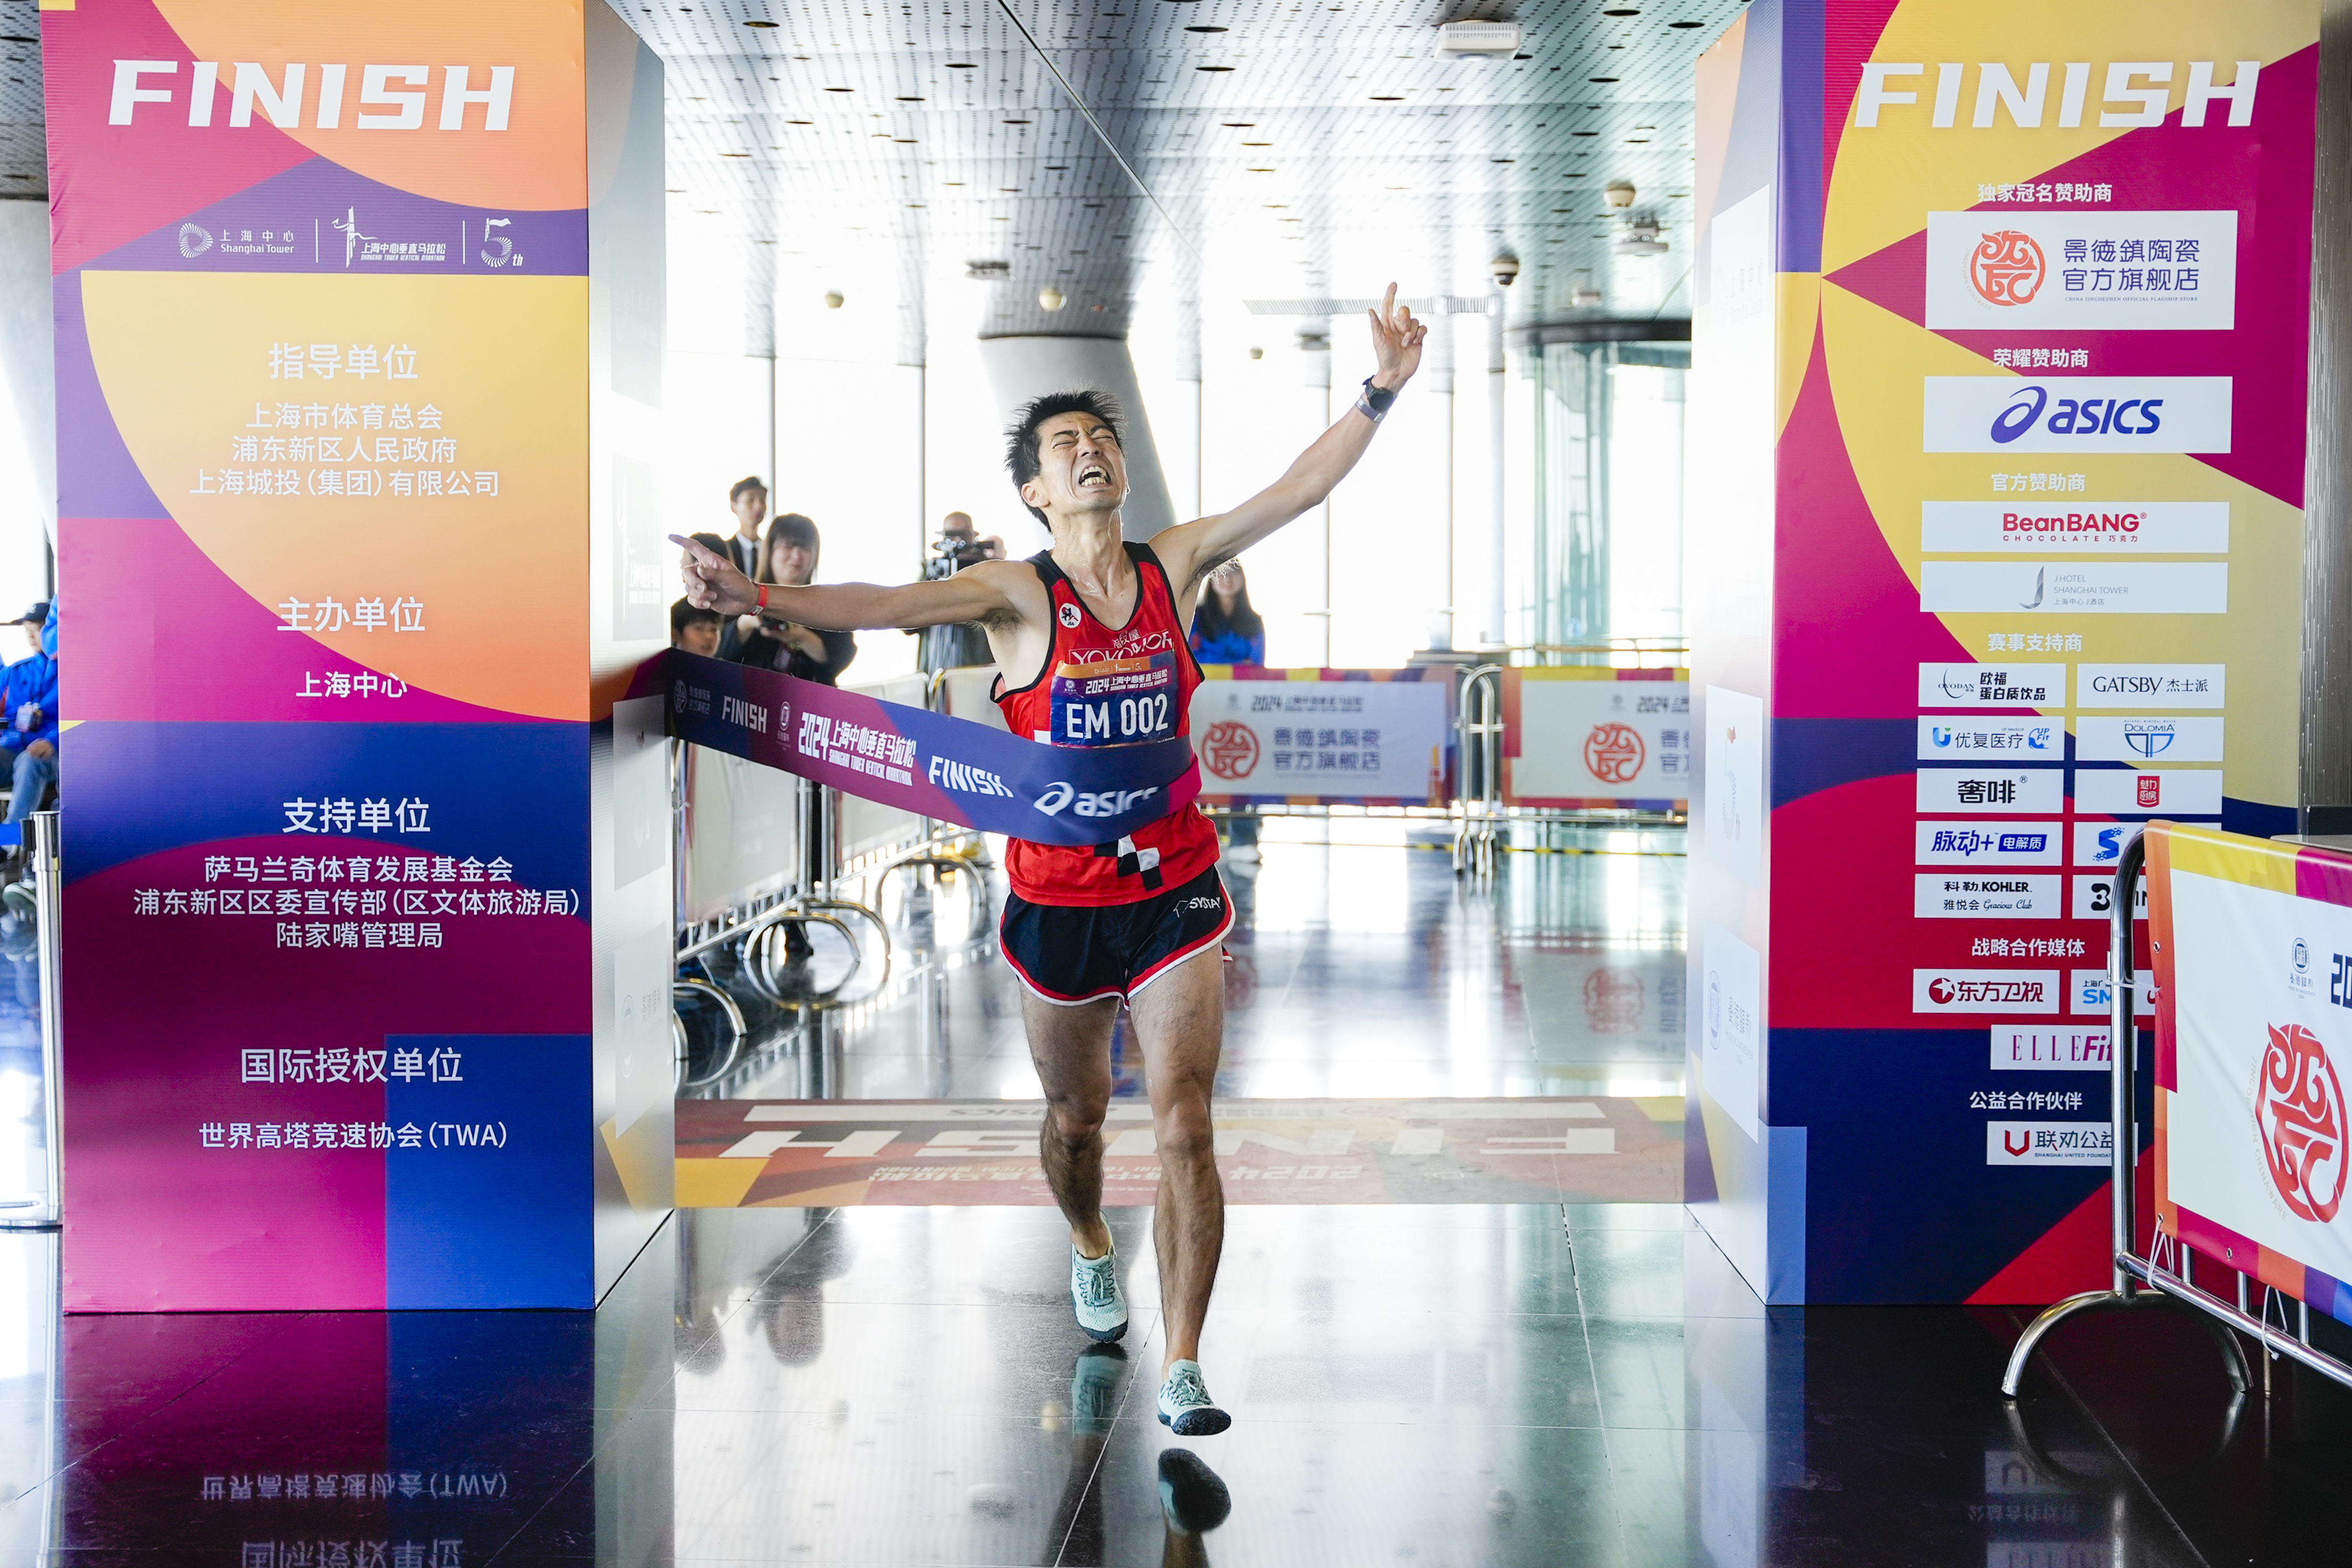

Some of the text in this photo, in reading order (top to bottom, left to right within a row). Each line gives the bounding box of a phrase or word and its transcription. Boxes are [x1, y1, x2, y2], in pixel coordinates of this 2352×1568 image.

[108, 59, 515, 131] FINISH
[1854, 61, 2261, 129] FINISH
[1977, 183, 2112, 202] 独家冠名赞助商
[220, 229, 294, 242] 上海中心
[221, 244, 294, 255] Shanghai Tower
[361, 243, 445, 254] 上海中心垂直马拉松
[2062, 268, 2199, 291] 官方旗舰店
[269, 343, 418, 379] 指导单位
[1993, 349, 2089, 367] 荣耀赞助商
[246, 402, 443, 430] 上海市体育总会
[232, 435, 457, 463] 浦东新区人民政府
[1991, 473, 2086, 491] 官方赞助商
[277, 596, 425, 632] 主办单位
[1988, 632, 2083, 652] 赛事支持商
[296, 671, 407, 698] 上海中心
[1085, 678, 1109, 694] 2024
[1980, 672, 2007, 685] 欧福
[2093, 676, 2208, 695] GATSBY 杰士派
[1979, 687, 2046, 700] 蛋白质饮品
[722, 695, 767, 734] FINISH
[1066, 694, 1169, 739] EM 002
[798, 712, 831, 760] 2024
[829, 719, 917, 768] 上海中心垂直马拉松
[1955, 732, 2024, 748] 优复医疗
[928, 755, 1014, 798] FINISH
[283, 797, 430, 834] 支持单位
[2003, 837, 2043, 850] 电解质
[204, 856, 513, 883] 萨马兰奇体育发展基金会
[1944, 899, 2032, 911] 雅悦会 Gracious Club
[276, 921, 443, 948] 陆家嘴管理局
[1971, 938, 2085, 957] 战略合作媒体
[1957, 981, 2044, 1002] 东方卫视
[241, 1047, 463, 1083] 国际授权单位
[1969, 1091, 2083, 1110] 公益合作伙伴
[1229, 1166, 1363, 1181] 2024
